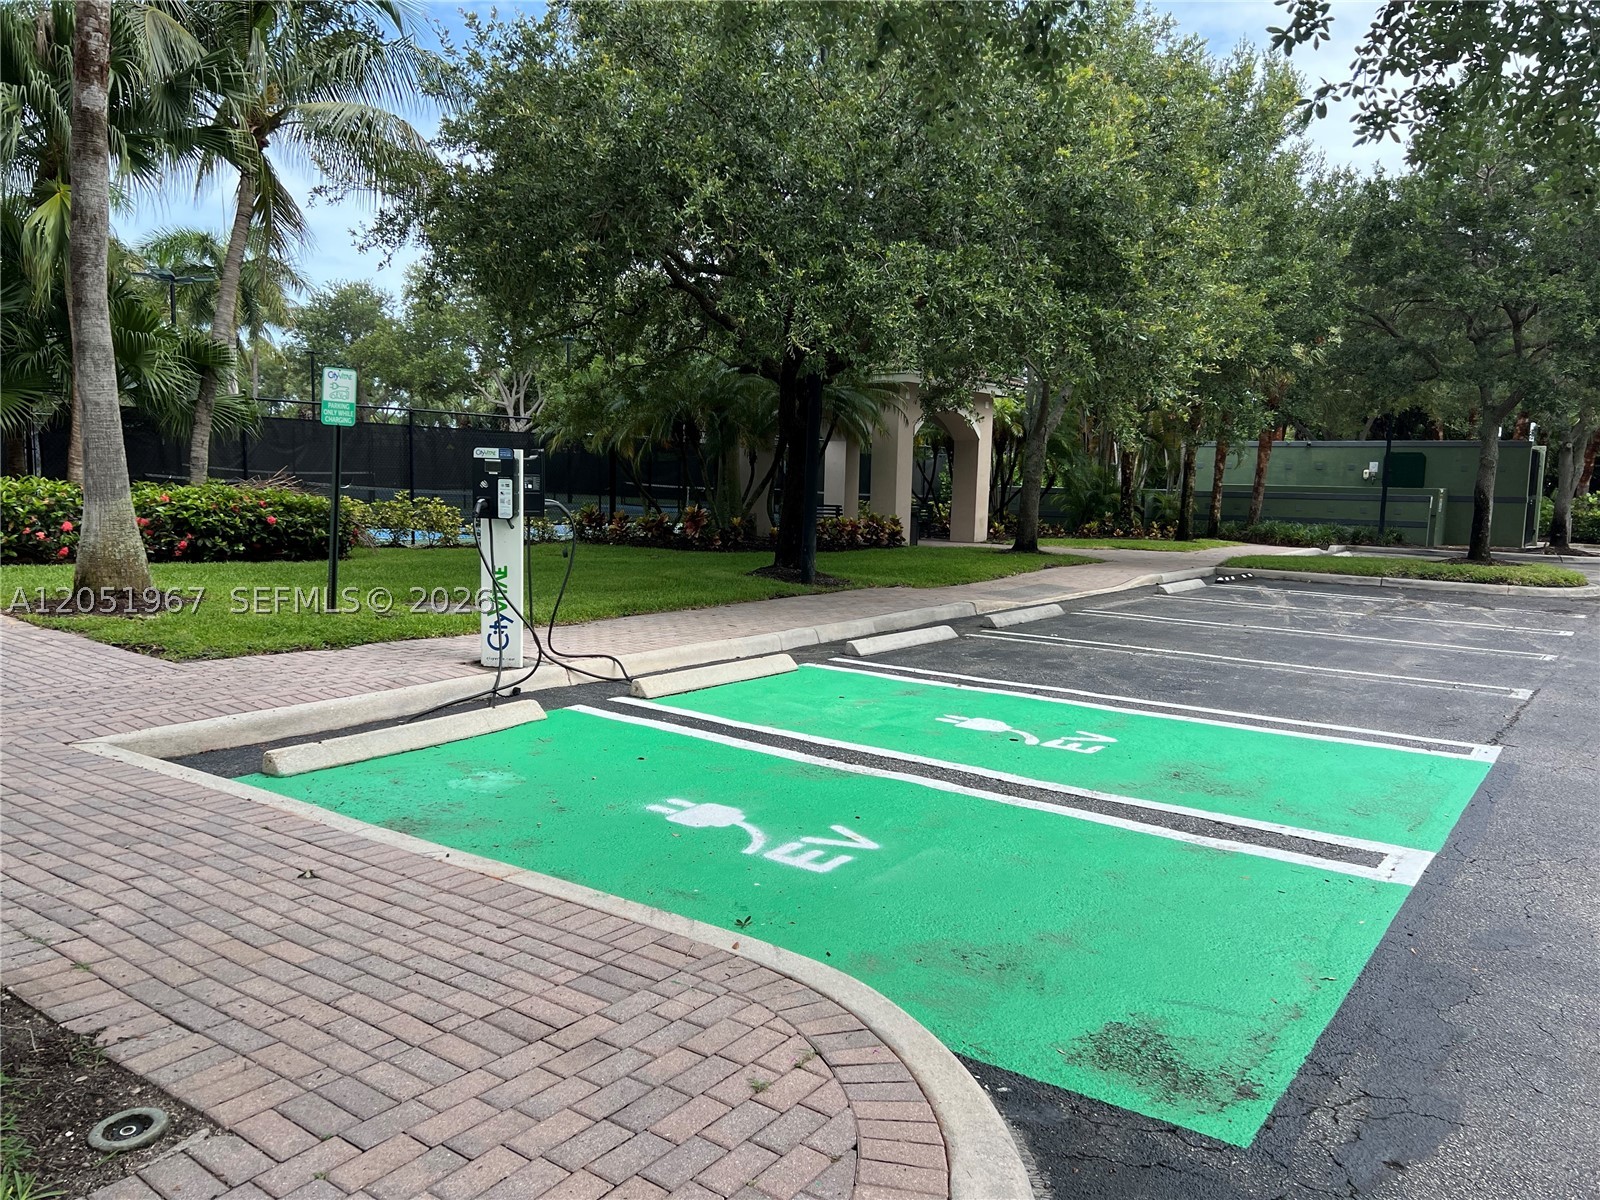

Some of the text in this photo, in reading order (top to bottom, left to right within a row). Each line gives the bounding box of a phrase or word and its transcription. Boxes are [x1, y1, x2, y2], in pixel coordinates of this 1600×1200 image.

[328, 402, 350, 410] PARKING
[325, 416, 352, 424] CHARGING
[1040, 730, 1119, 754] EV
[763, 824, 881, 873] EV
